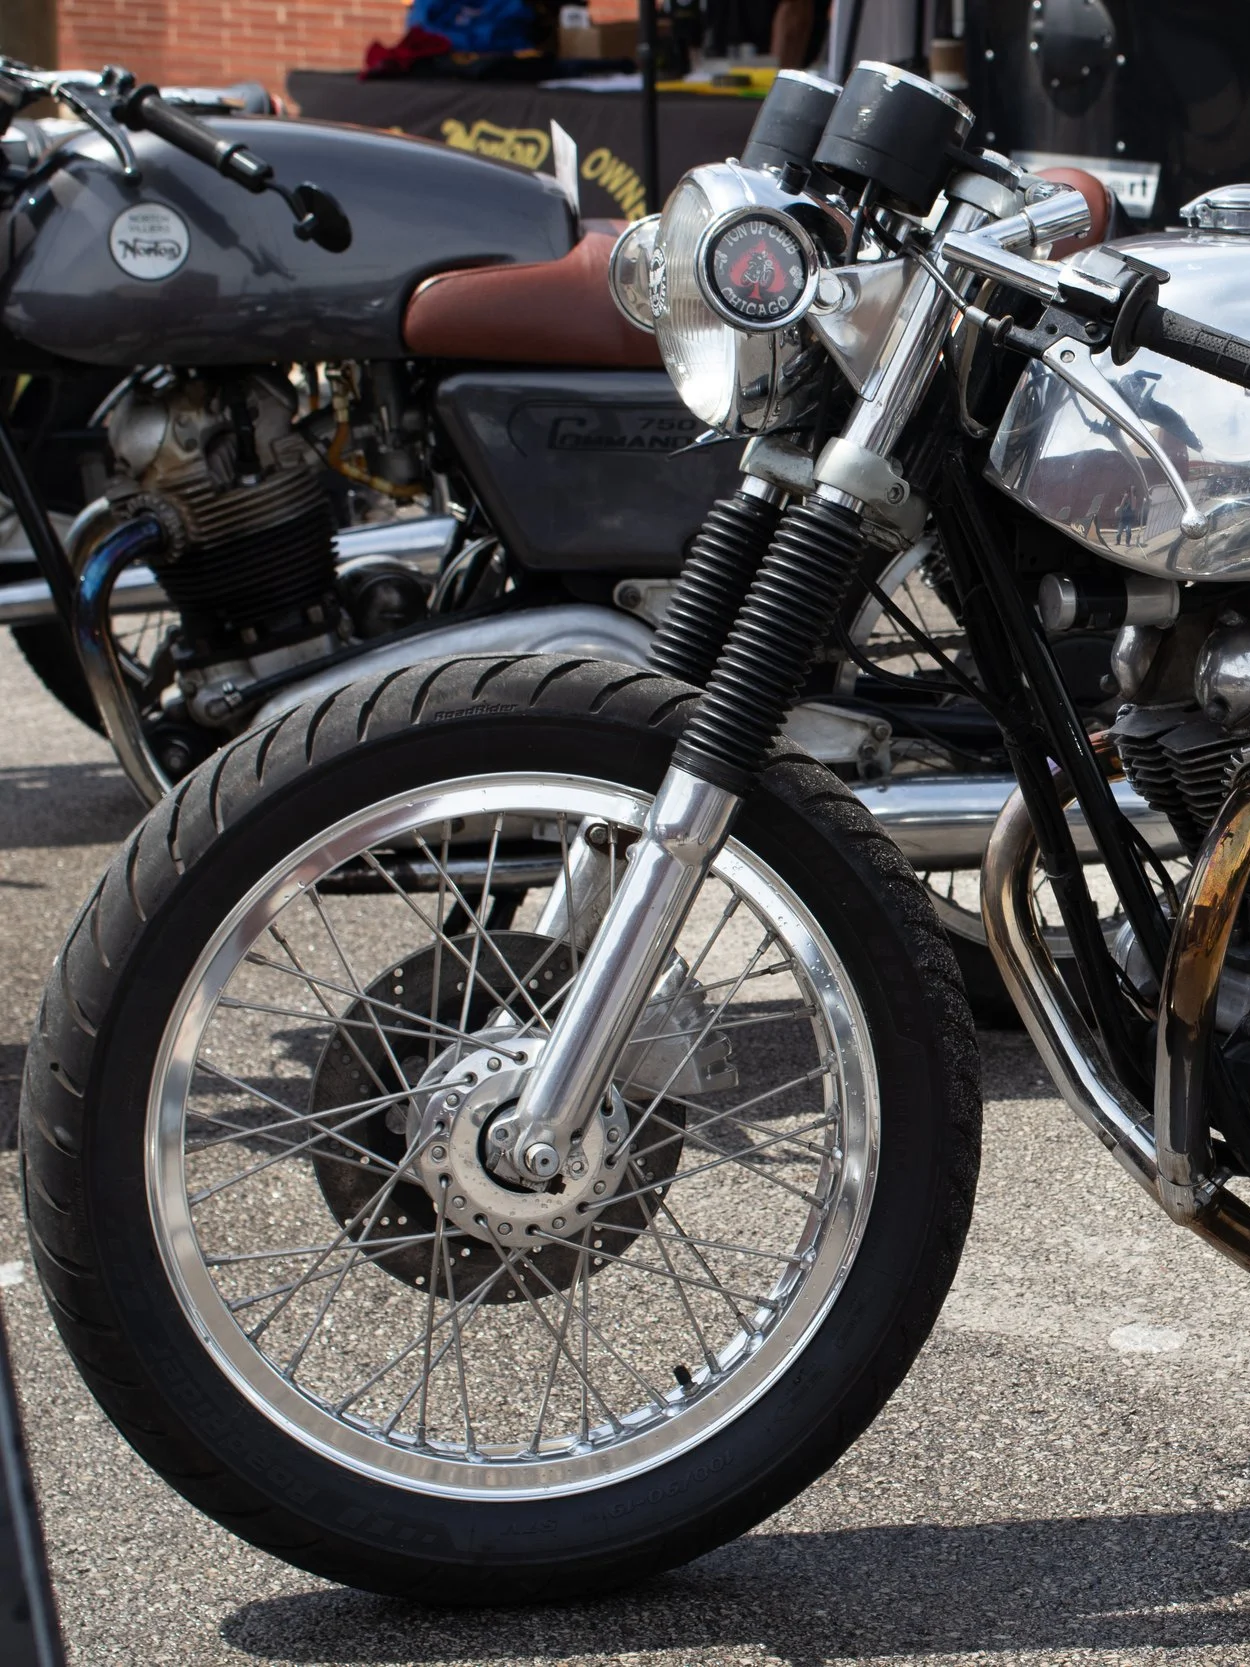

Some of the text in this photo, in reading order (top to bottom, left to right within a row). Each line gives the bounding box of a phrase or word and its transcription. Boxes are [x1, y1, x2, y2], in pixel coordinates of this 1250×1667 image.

[117, 237, 182, 261] Norton
[722, 220, 800, 256] TON UP CLUB
[720, 286, 789, 316] CHICAGO
[638, 416, 697, 432] 750
[433, 702, 519, 721] RoadRider
